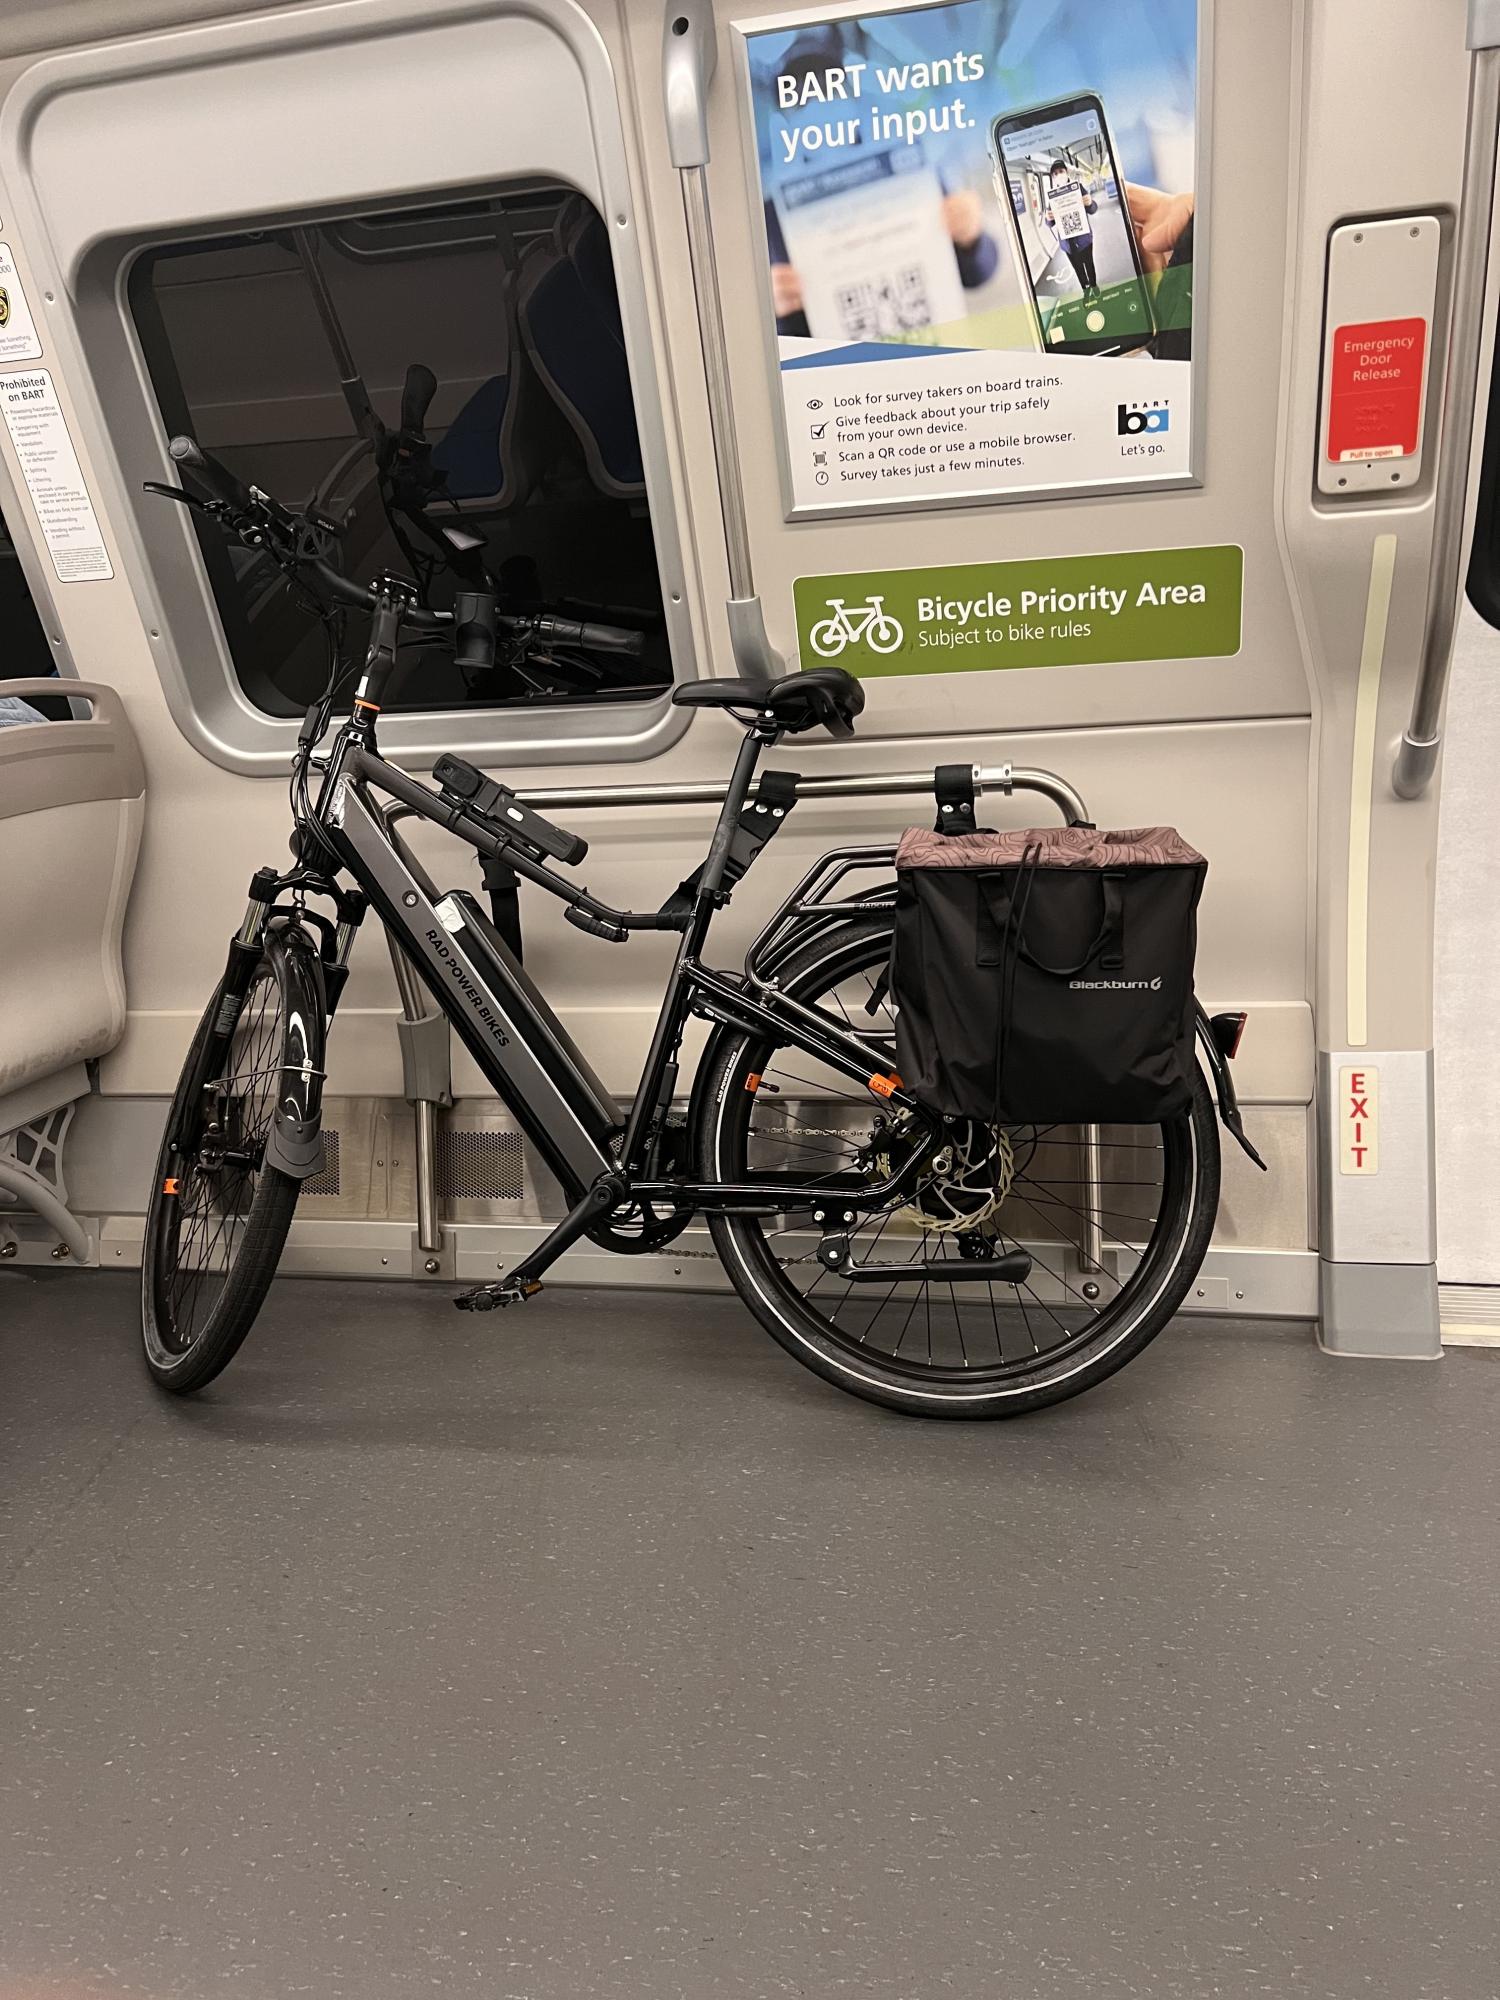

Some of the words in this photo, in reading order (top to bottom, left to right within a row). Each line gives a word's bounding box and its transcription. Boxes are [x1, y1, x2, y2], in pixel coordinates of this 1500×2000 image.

[777, 63, 867, 109] BART
[876, 50, 985, 93] wants
[780, 117, 861, 163] your
[871, 98, 976, 145] input.
[1344, 337, 1415, 353] Emergency
[1360, 354, 1392, 366] Door
[0, 376, 46, 391] Prohibited
[1353, 368, 1401, 381] Release
[8, 394, 20, 402] on
[21, 389, 45, 401] BART
[834, 394, 862, 408] Look
[865, 392, 883, 405] for
[886, 389, 923, 403] survey
[927, 385, 963, 399] takers
[966, 384, 982, 395] on
[986, 378, 1022, 394] board
[1025, 375, 1063, 389] trains.
[835, 414, 861, 428] Give
[864, 409, 918, 424] feedback
[921, 406, 956, 419] about
[959, 403, 986, 418] your
[990, 401, 1012, 414] trip
[1014, 397, 1050, 411] safely
[1132, 400, 1169, 409] BART
[838, 431, 865, 443] from
[868, 428, 895, 442] your
[898, 426, 923, 437] own
[926, 422, 968, 435] device.
[838, 451, 865, 463] Scan
[868, 450, 875, 460] a
[878, 447, 896, 460] QR
[898, 444, 926, 457] code
[929, 444, 942, 454] or
[945, 442, 965, 452] use
[968, 440, 976, 450] a
[979, 436, 1020, 449] mobile
[1023, 432, 1076, 446] browser.
[1120, 444, 1145, 456] Let's
[1148, 445, 1165, 456] go.
[1350, 451, 1364, 459] Pull
[1375, 450, 1393, 458] open
[840, 468, 878, 482] Survey
[881, 464, 912, 478] takes
[914, 462, 935, 477] just
[938, 463, 946, 472] a
[948, 460, 971, 471] few
[974, 456, 1025, 470] minutes.
[918, 591, 1012, 625] Bicycle
[1021, 585, 1127, 615] Priority
[1135, 582, 1207, 607] Area
[919, 628, 980, 649] Subject
[985, 626, 1003, 643] to
[1008, 622, 1045, 641] bike
[1050, 619, 1092, 639] rules
[425, 929, 449, 958] RAD
[446, 958, 483, 1009] POWER
[478, 1007, 510, 1047] BIKES
[1069, 980, 1149, 989] Blackburn
[1350, 1073, 1369, 1168] EXIT
